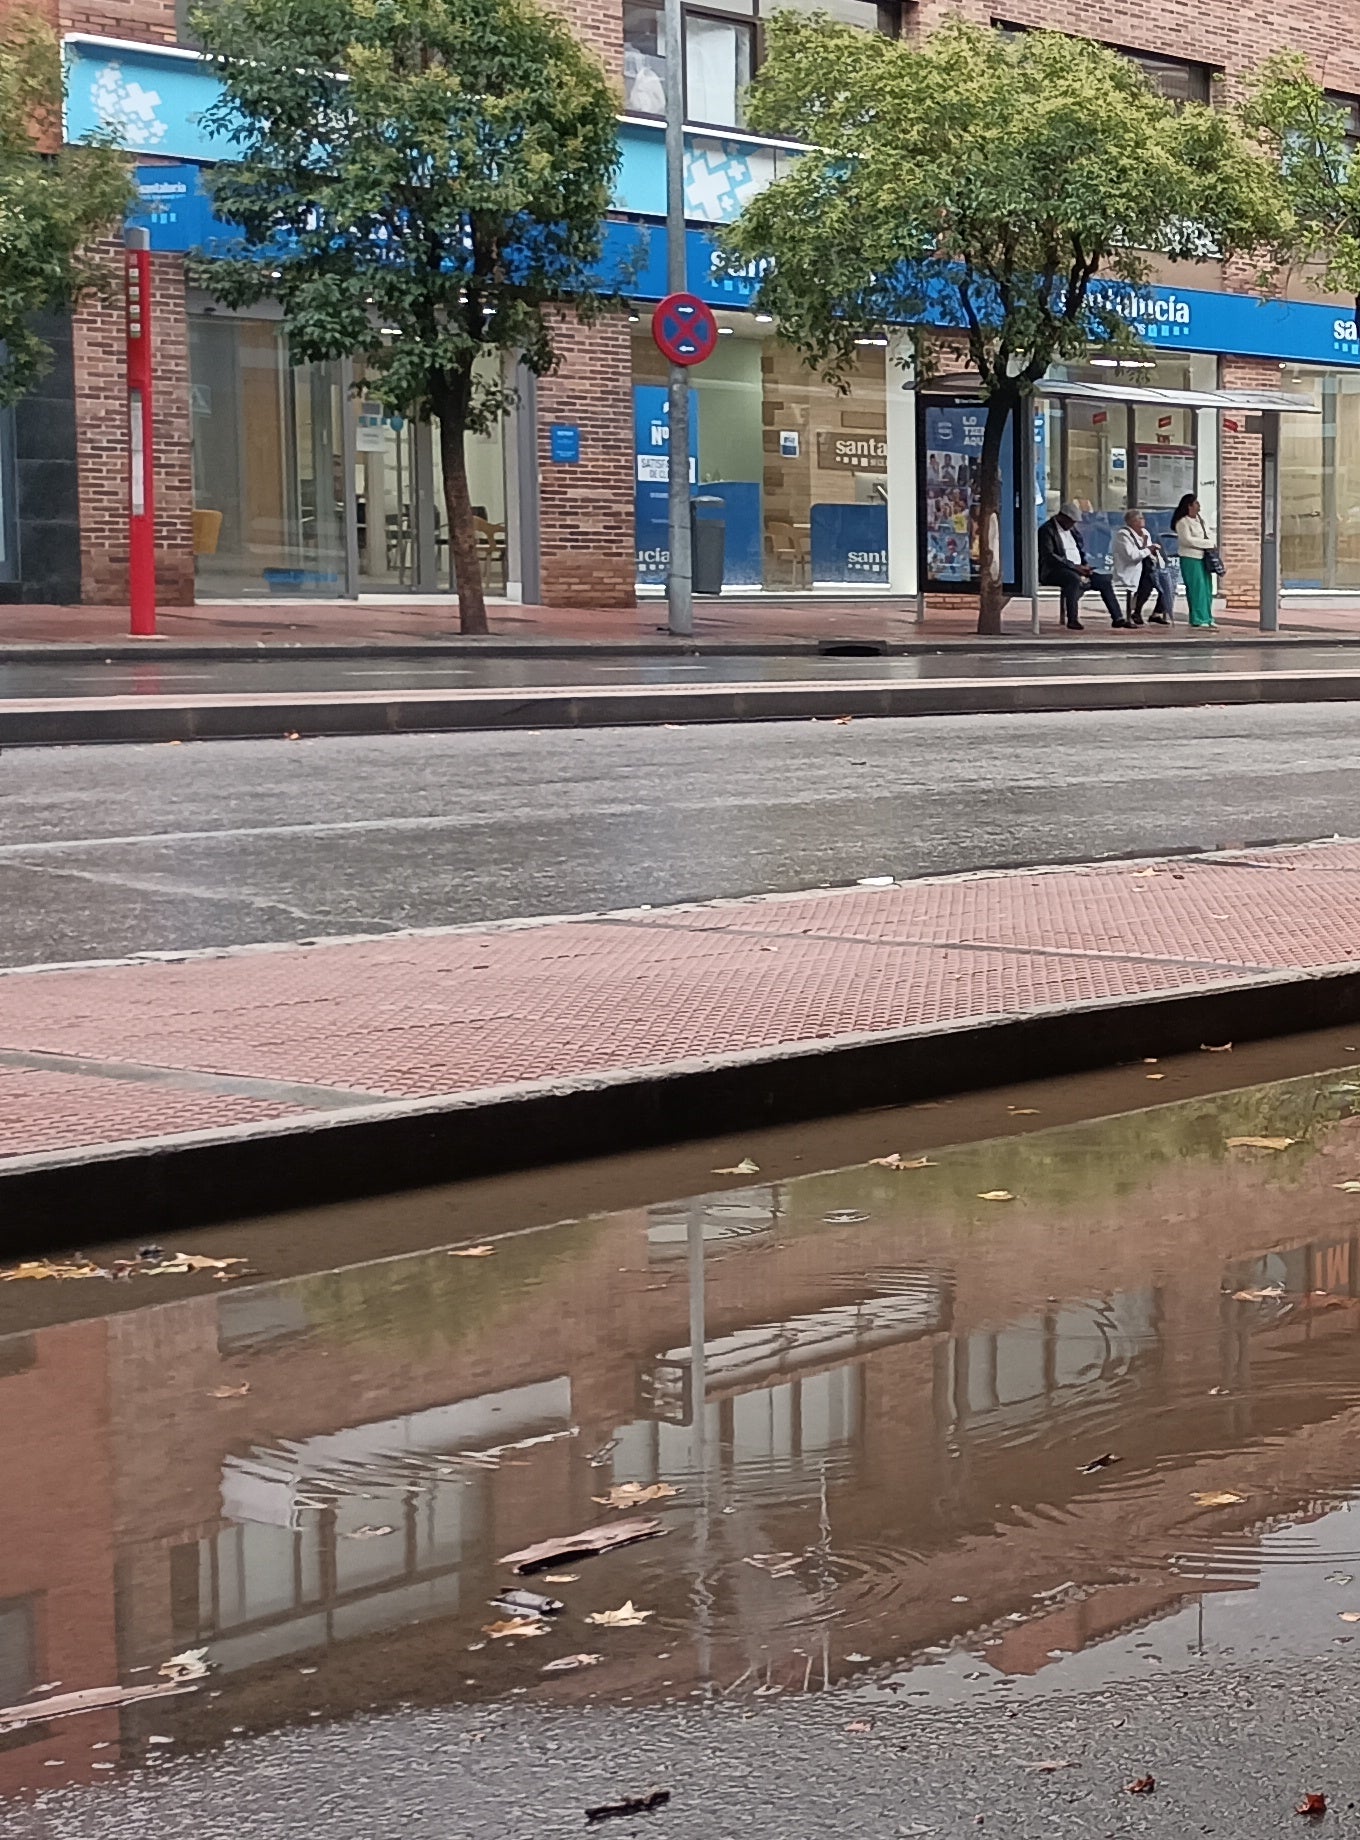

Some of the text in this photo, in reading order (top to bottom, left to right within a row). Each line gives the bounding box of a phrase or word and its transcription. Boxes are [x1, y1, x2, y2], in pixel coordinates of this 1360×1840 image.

[962, 415, 978, 426] LO
[835, 438, 887, 456] santa
[963, 436, 984, 446] AQU
[634, 547, 670, 563] ucía
[847, 550, 887, 563] sant
